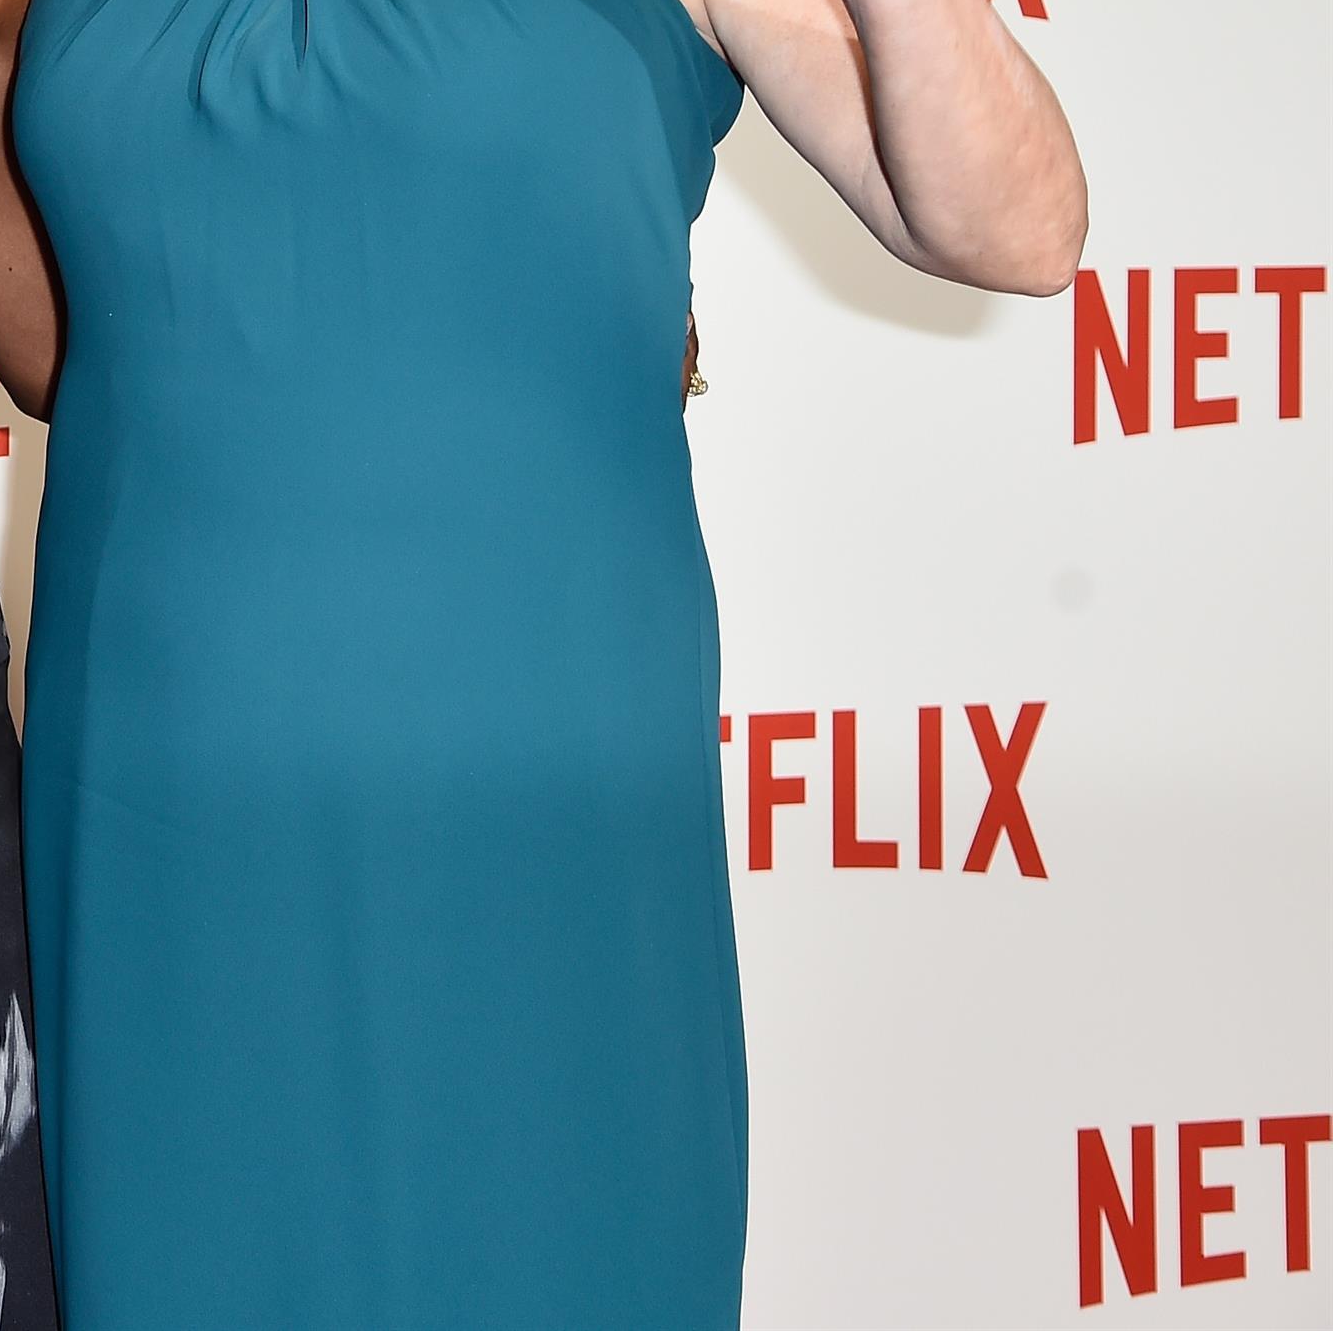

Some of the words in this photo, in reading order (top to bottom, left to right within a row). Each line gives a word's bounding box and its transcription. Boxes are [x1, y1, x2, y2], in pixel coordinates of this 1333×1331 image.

[1073, 266, 1327, 445] NET
[719, 701, 1049, 879] FLIX
[1076, 1113, 1333, 1309] NET
